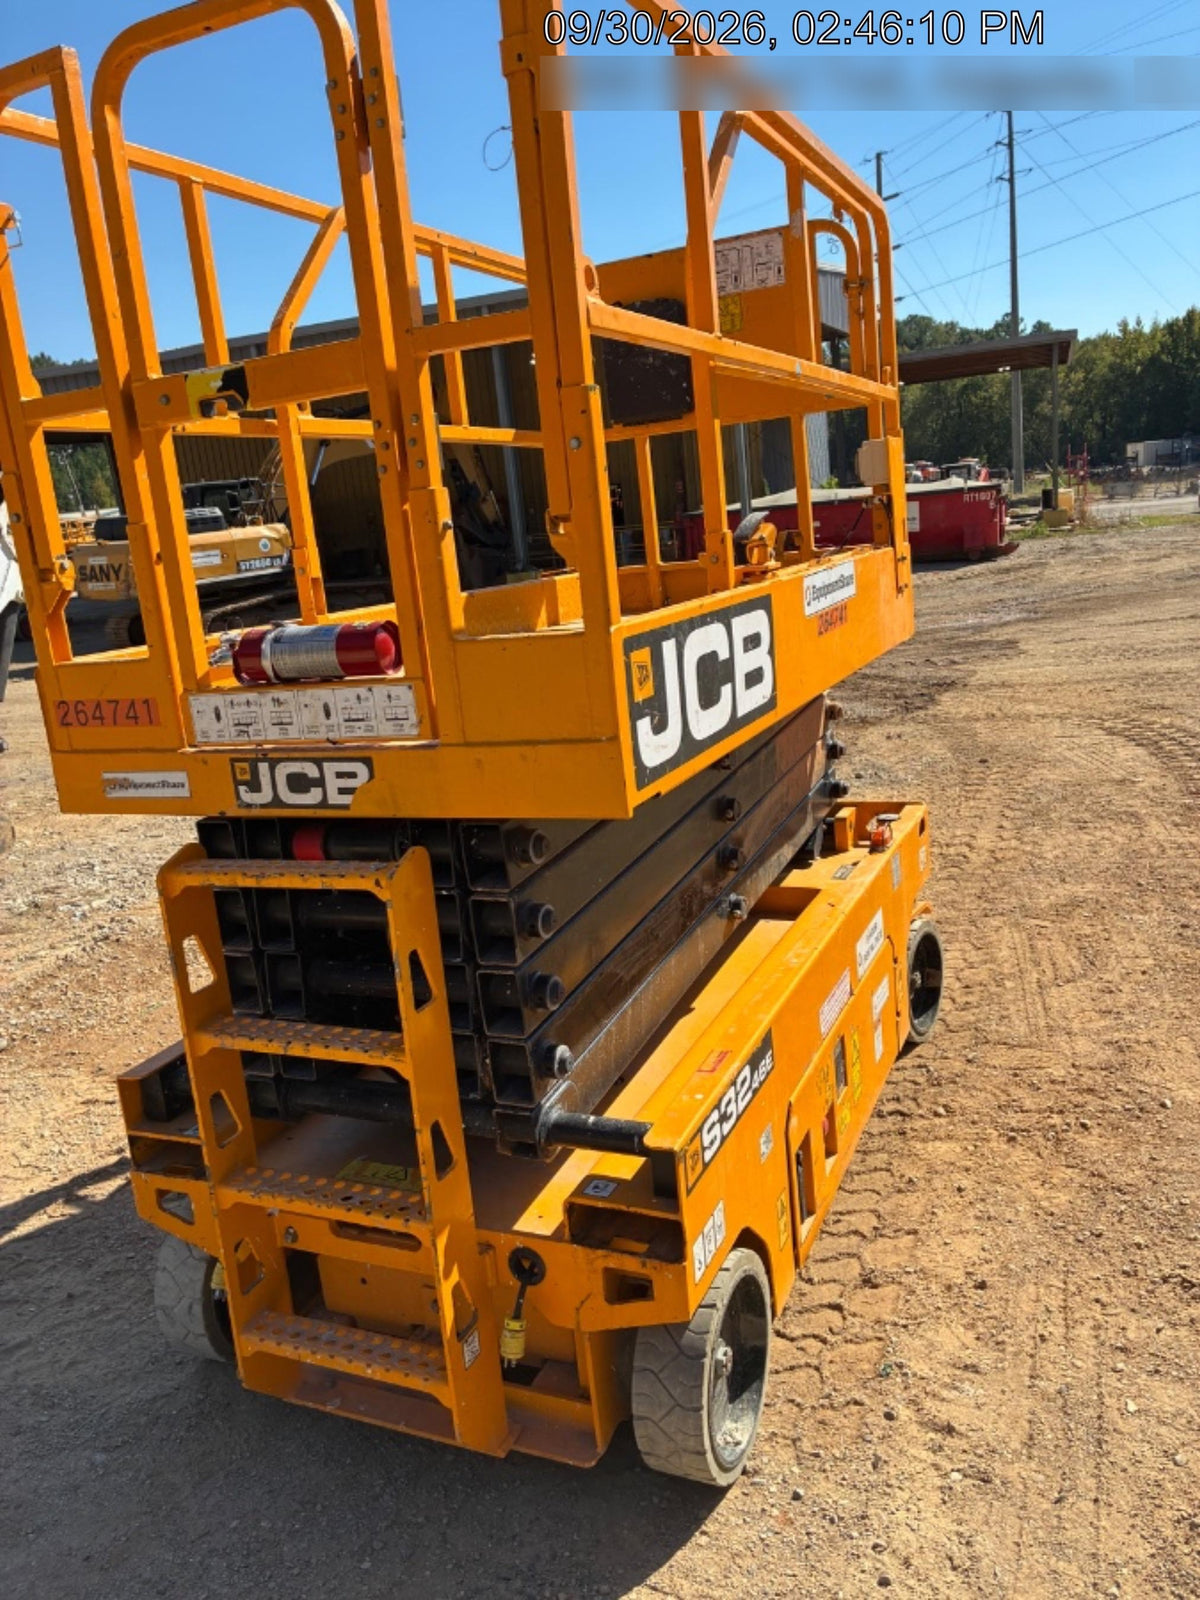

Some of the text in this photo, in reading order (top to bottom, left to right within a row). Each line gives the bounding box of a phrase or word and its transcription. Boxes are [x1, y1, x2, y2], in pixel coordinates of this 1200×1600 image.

[79, 563, 123, 582] SANY
[636, 609, 774, 768] JCB
[57, 698, 155, 727] 264741
[238, 762, 370, 804] JCB
